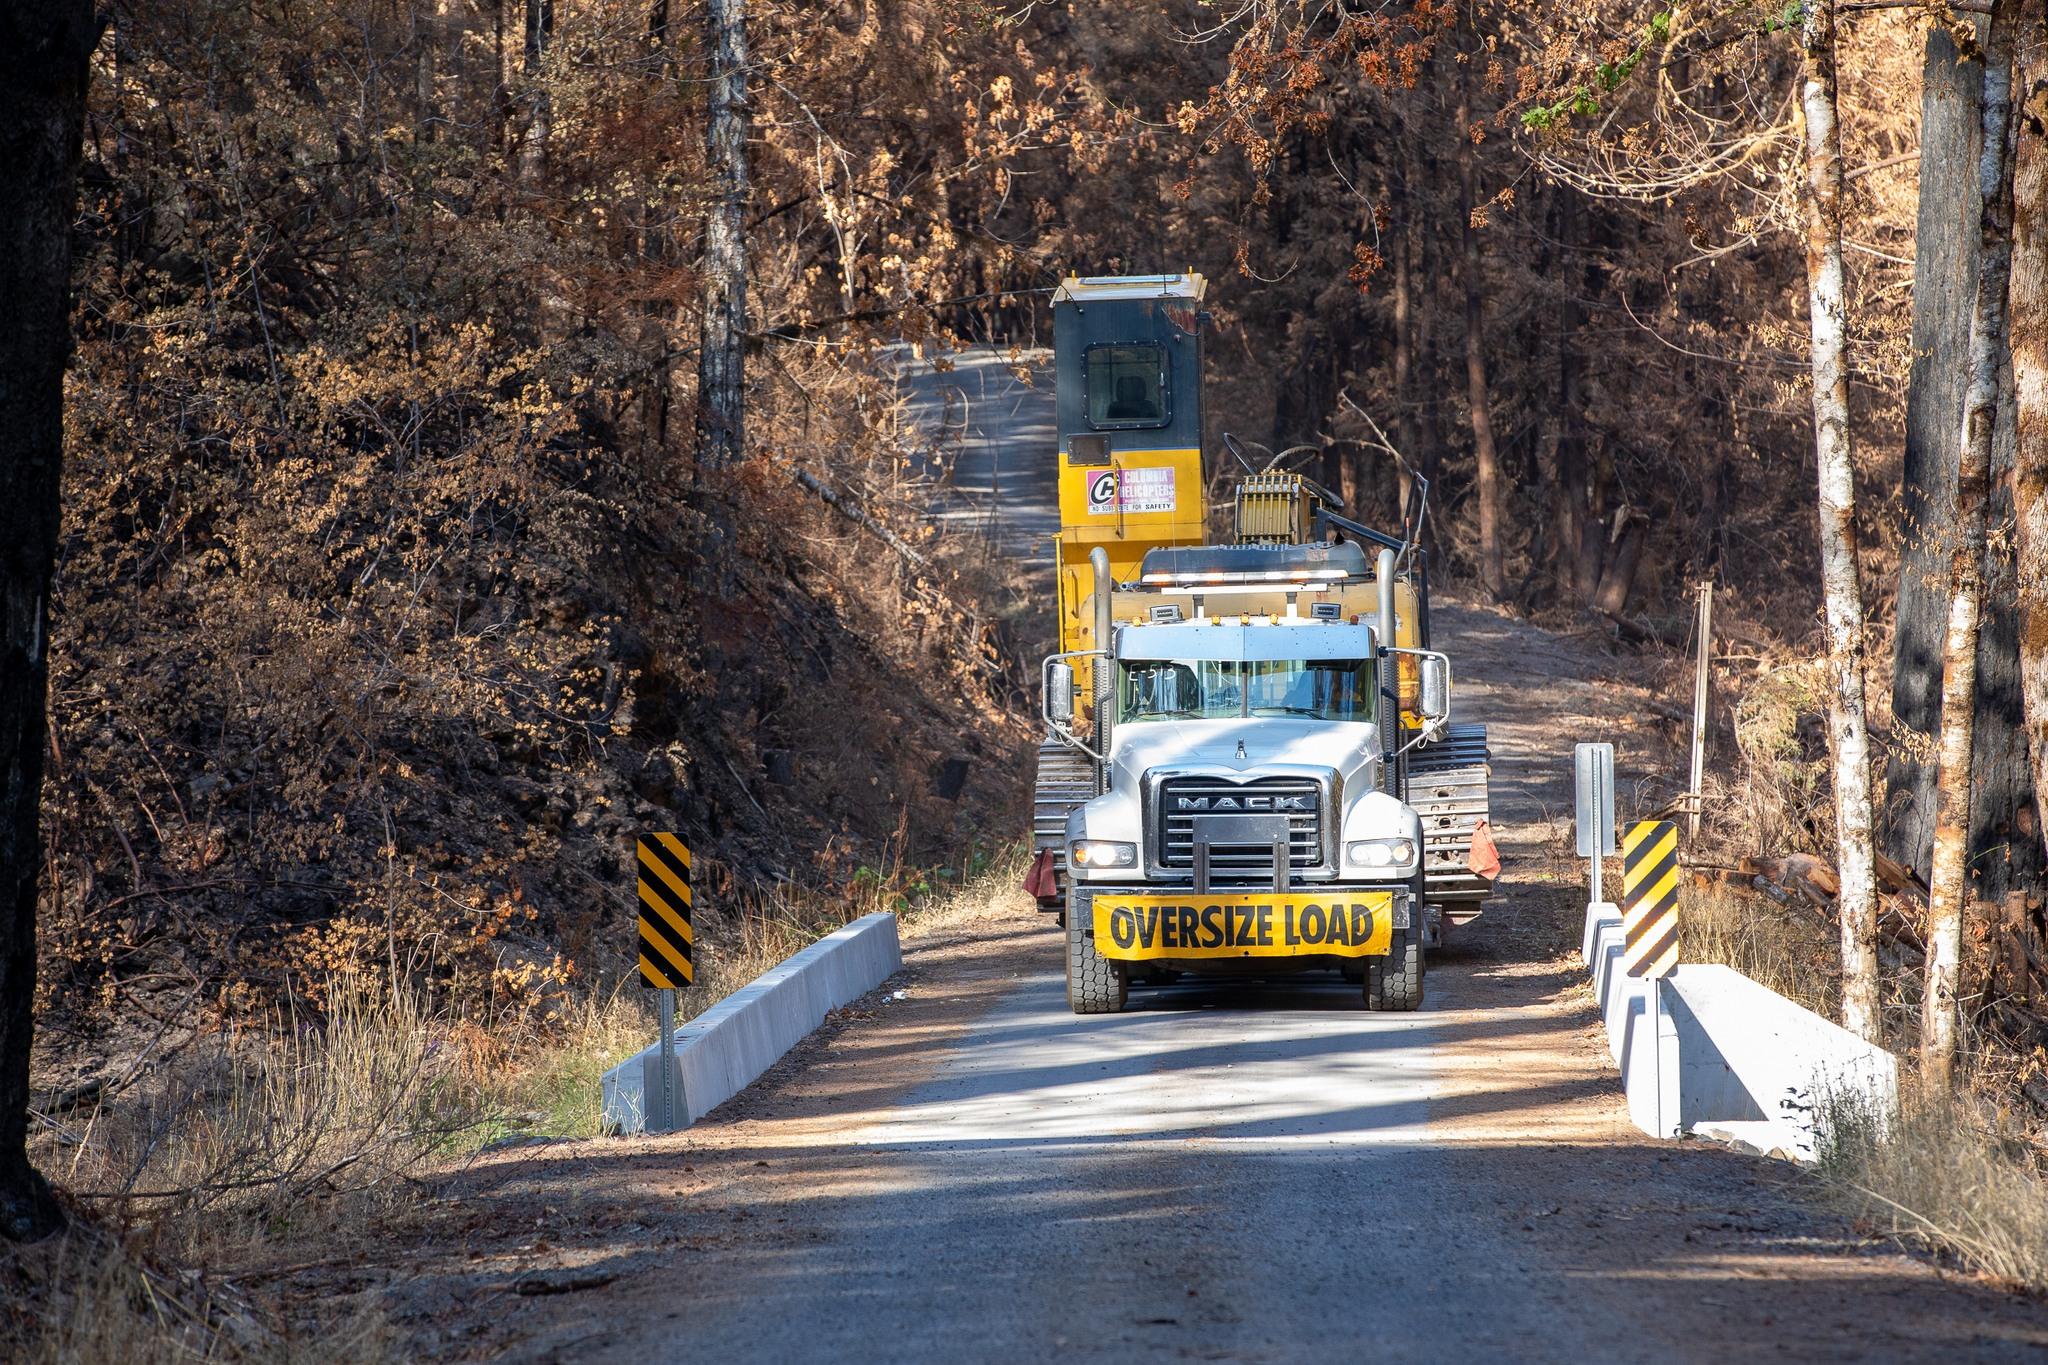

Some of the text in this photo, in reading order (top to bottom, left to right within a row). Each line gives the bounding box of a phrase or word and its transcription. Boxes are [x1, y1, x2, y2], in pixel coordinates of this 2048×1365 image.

[1120, 484, 1174, 498] HELICOPTERS
[1129, 663, 1176, 681] E-513
[1178, 796, 1306, 810] MACK
[1110, 904, 1374, 948] OVERSIZE LOAD
